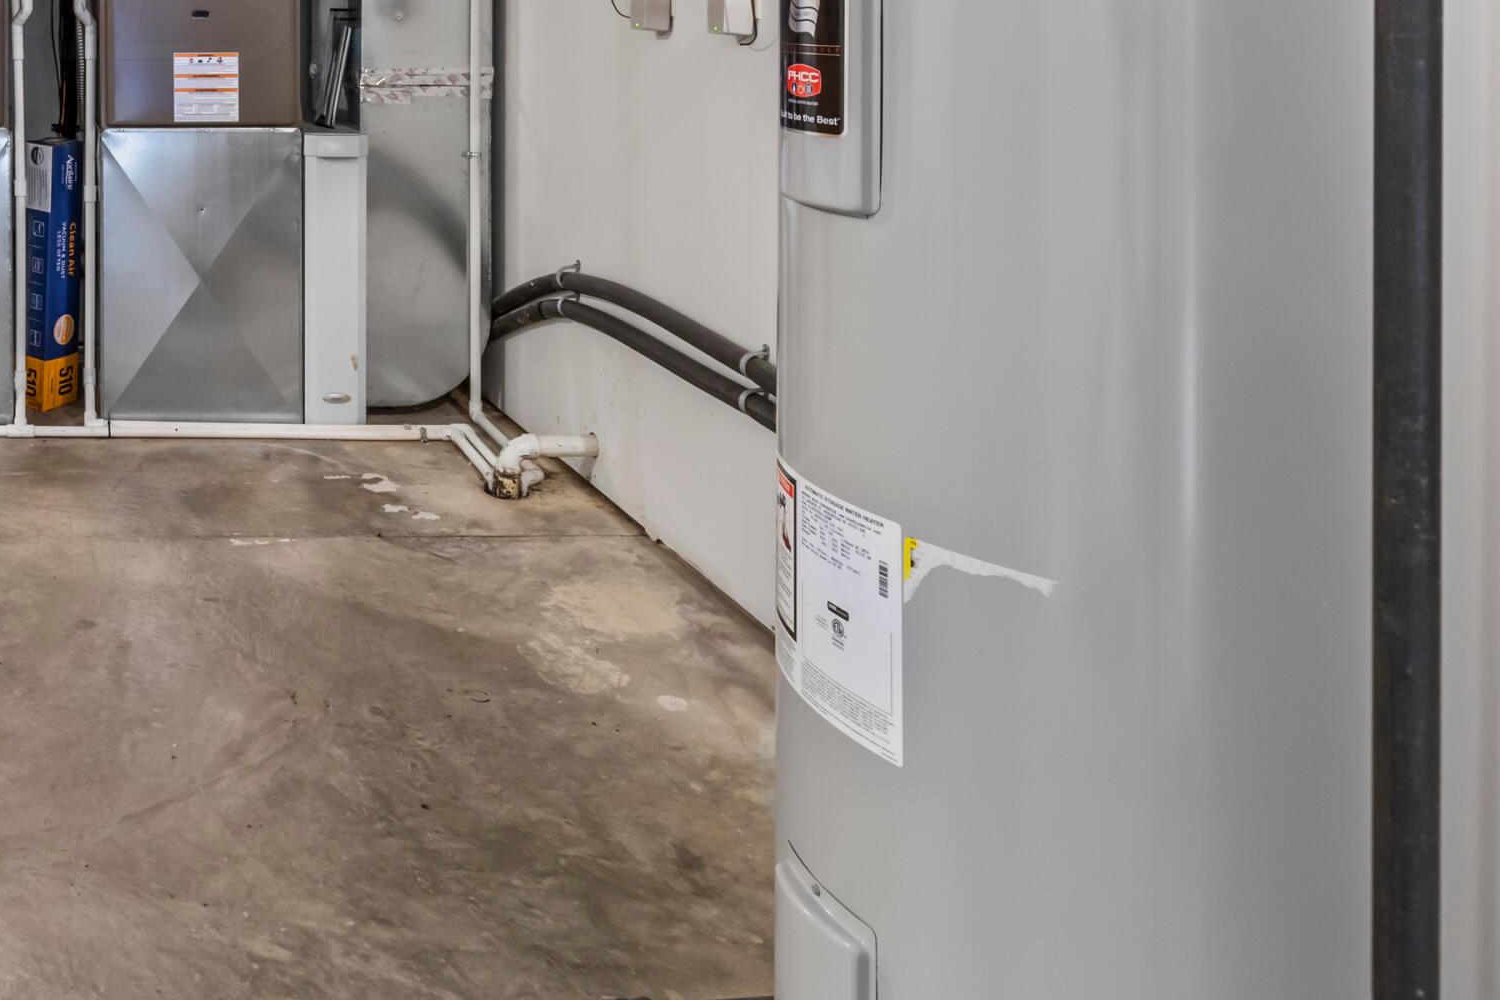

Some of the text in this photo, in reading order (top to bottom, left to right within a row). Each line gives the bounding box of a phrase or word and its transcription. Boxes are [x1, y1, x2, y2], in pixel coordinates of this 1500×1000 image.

[788, 70, 819, 83] PHCC
[803, 113, 815, 123] the
[817, 116, 838, 126] Best
[68, 222, 77, 277] Clean Air
[58, 365, 74, 396] 510
[845, 507, 862, 519] WATER
[863, 515, 884, 528] HEATER
